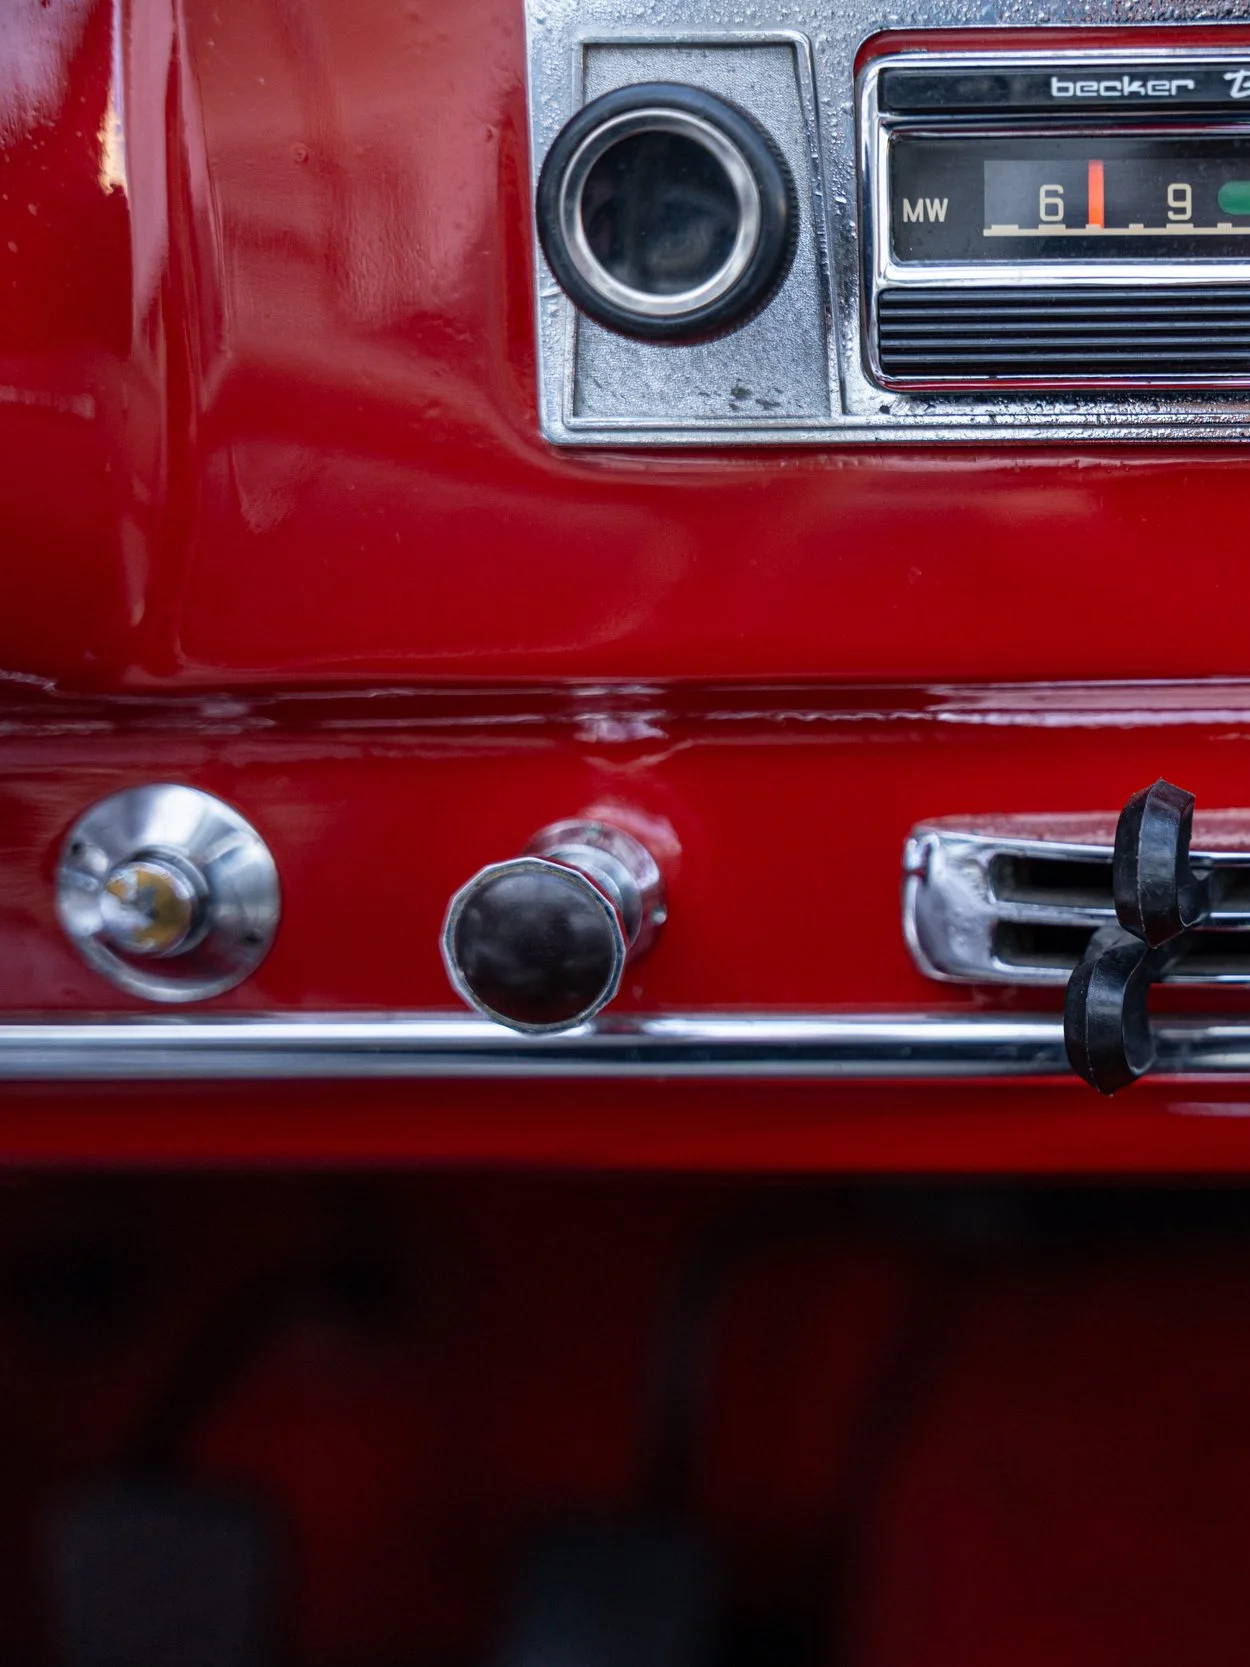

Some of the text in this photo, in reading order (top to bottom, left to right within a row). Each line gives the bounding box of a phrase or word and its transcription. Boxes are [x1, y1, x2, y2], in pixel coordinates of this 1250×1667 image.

[1051, 76, 1195, 97] becker
[902, 198, 948, 222] MW
[1039, 184, 1064, 221] 6
[1167, 183, 1192, 221] 9
